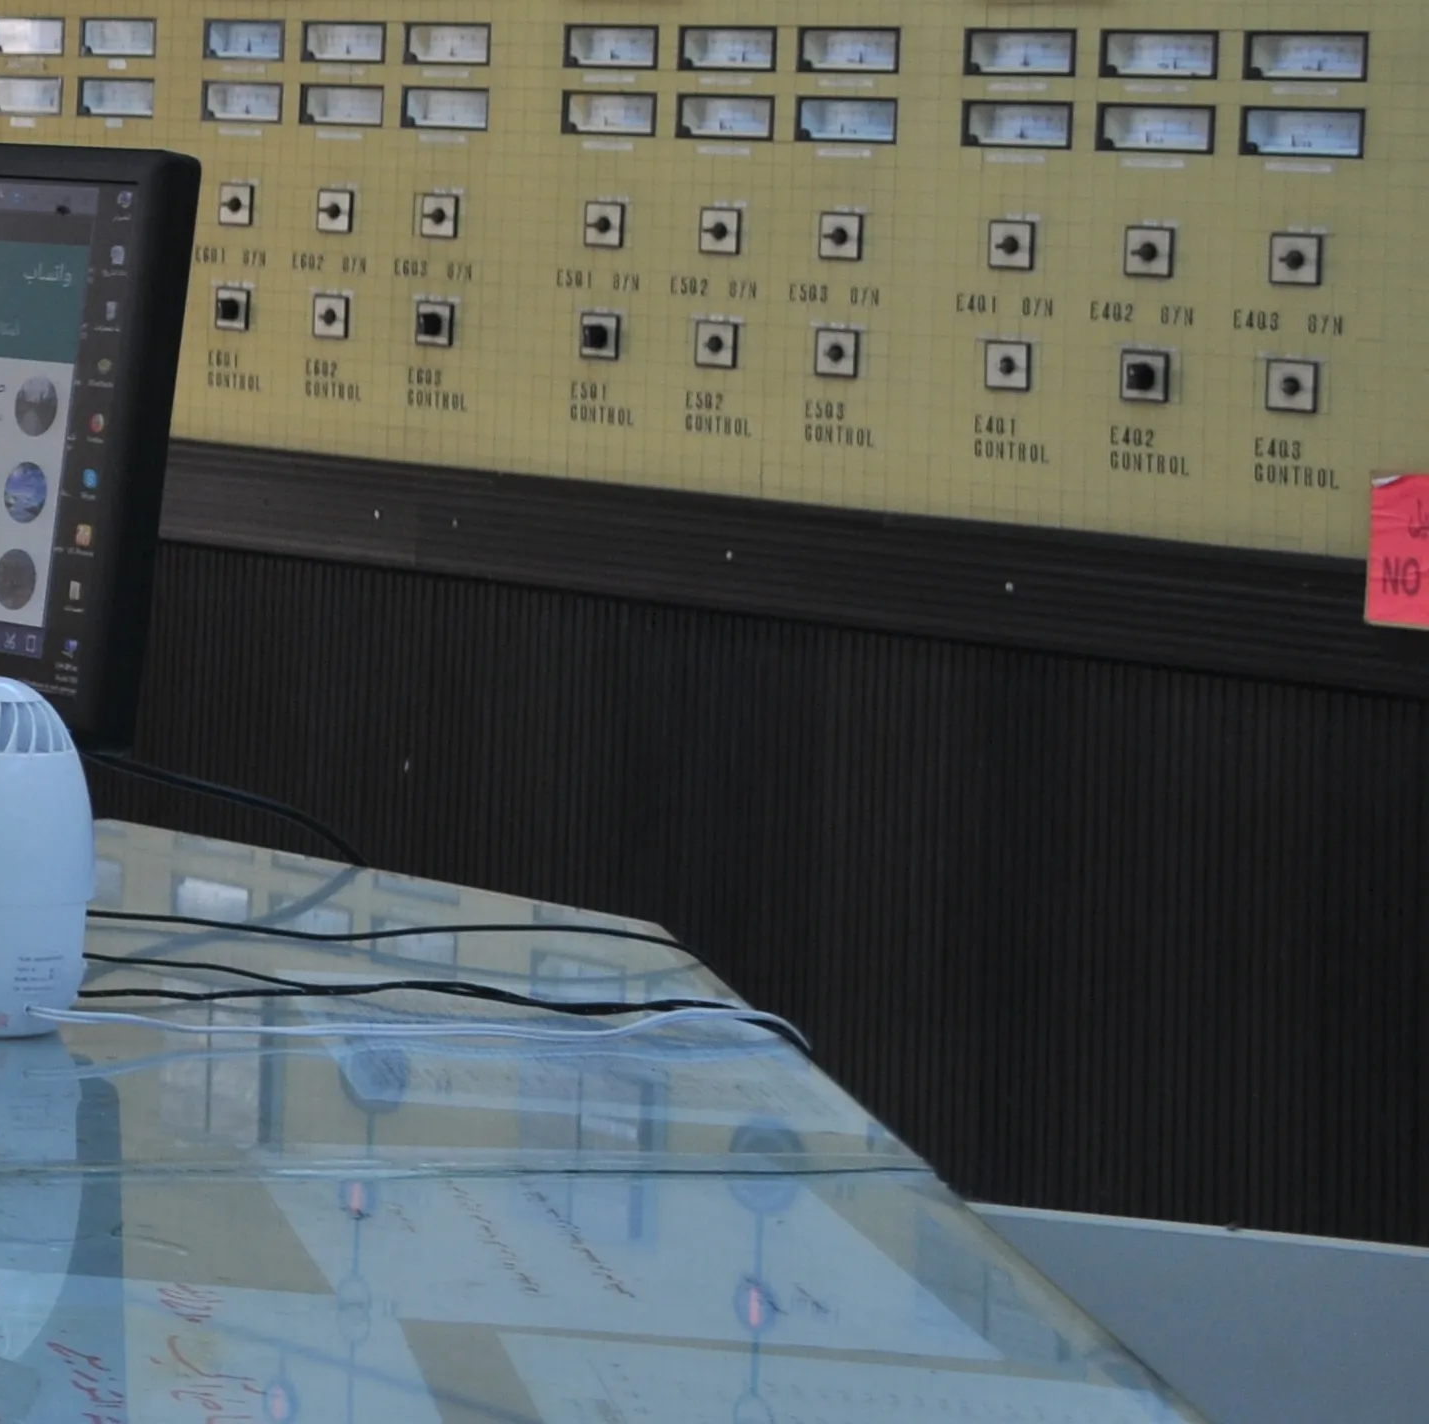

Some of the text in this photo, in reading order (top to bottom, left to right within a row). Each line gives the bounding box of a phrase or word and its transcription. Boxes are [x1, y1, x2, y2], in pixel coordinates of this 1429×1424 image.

[23, 263, 72, 287] واتساب
[570, 404, 633, 426] CONTROL
[685, 414, 751, 437] CONTROL
[805, 424, 873, 447] CONTROL
[974, 439, 1048, 463] CONTROL
[1110, 451, 1189, 476] CONTROL
[1255, 463, 1339, 489] CONTROL
[1382, 556, 1421, 597] NO
